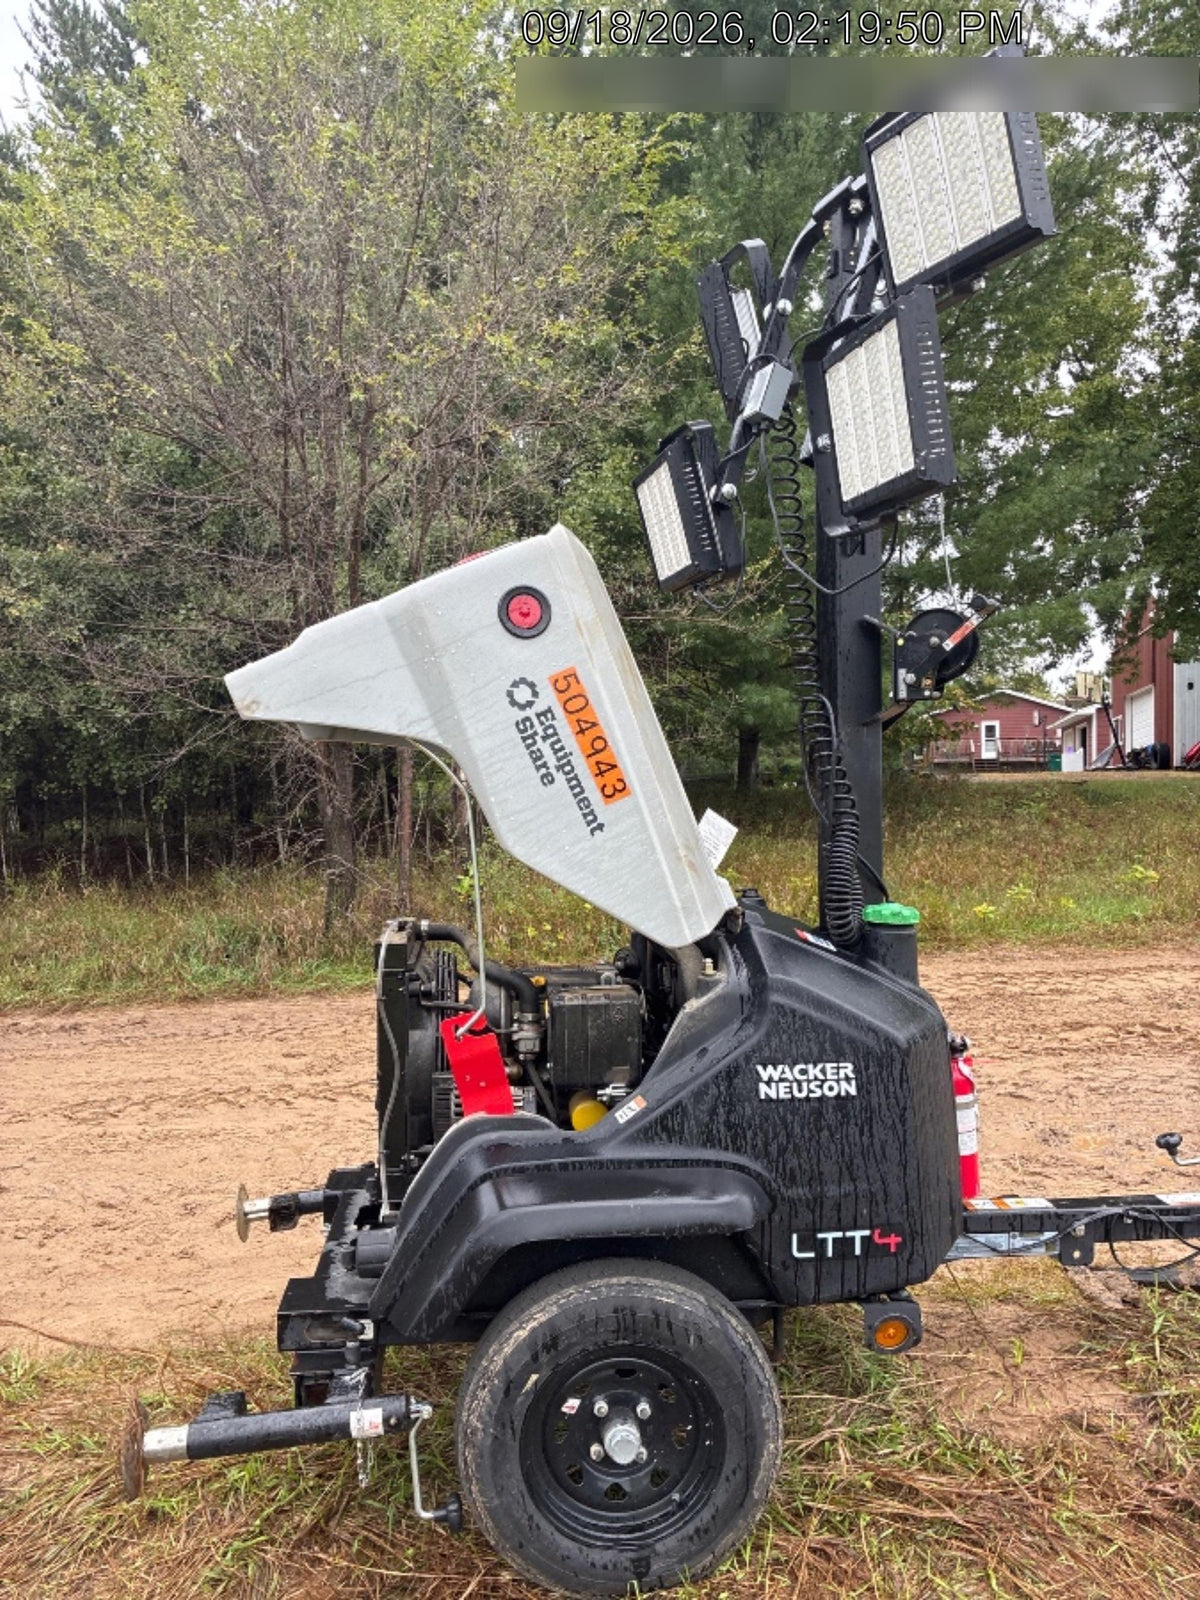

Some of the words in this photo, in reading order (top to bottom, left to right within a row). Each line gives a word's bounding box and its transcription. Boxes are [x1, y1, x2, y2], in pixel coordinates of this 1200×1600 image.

[515, 716, 556, 788] Share
[553, 672, 627, 799] 504943
[535, 706, 605, 837] Equipment
[756, 1062, 856, 1082] WACKER
[759, 1079, 858, 1100] NEUSON
[792, 1227, 902, 1258] LTT4
